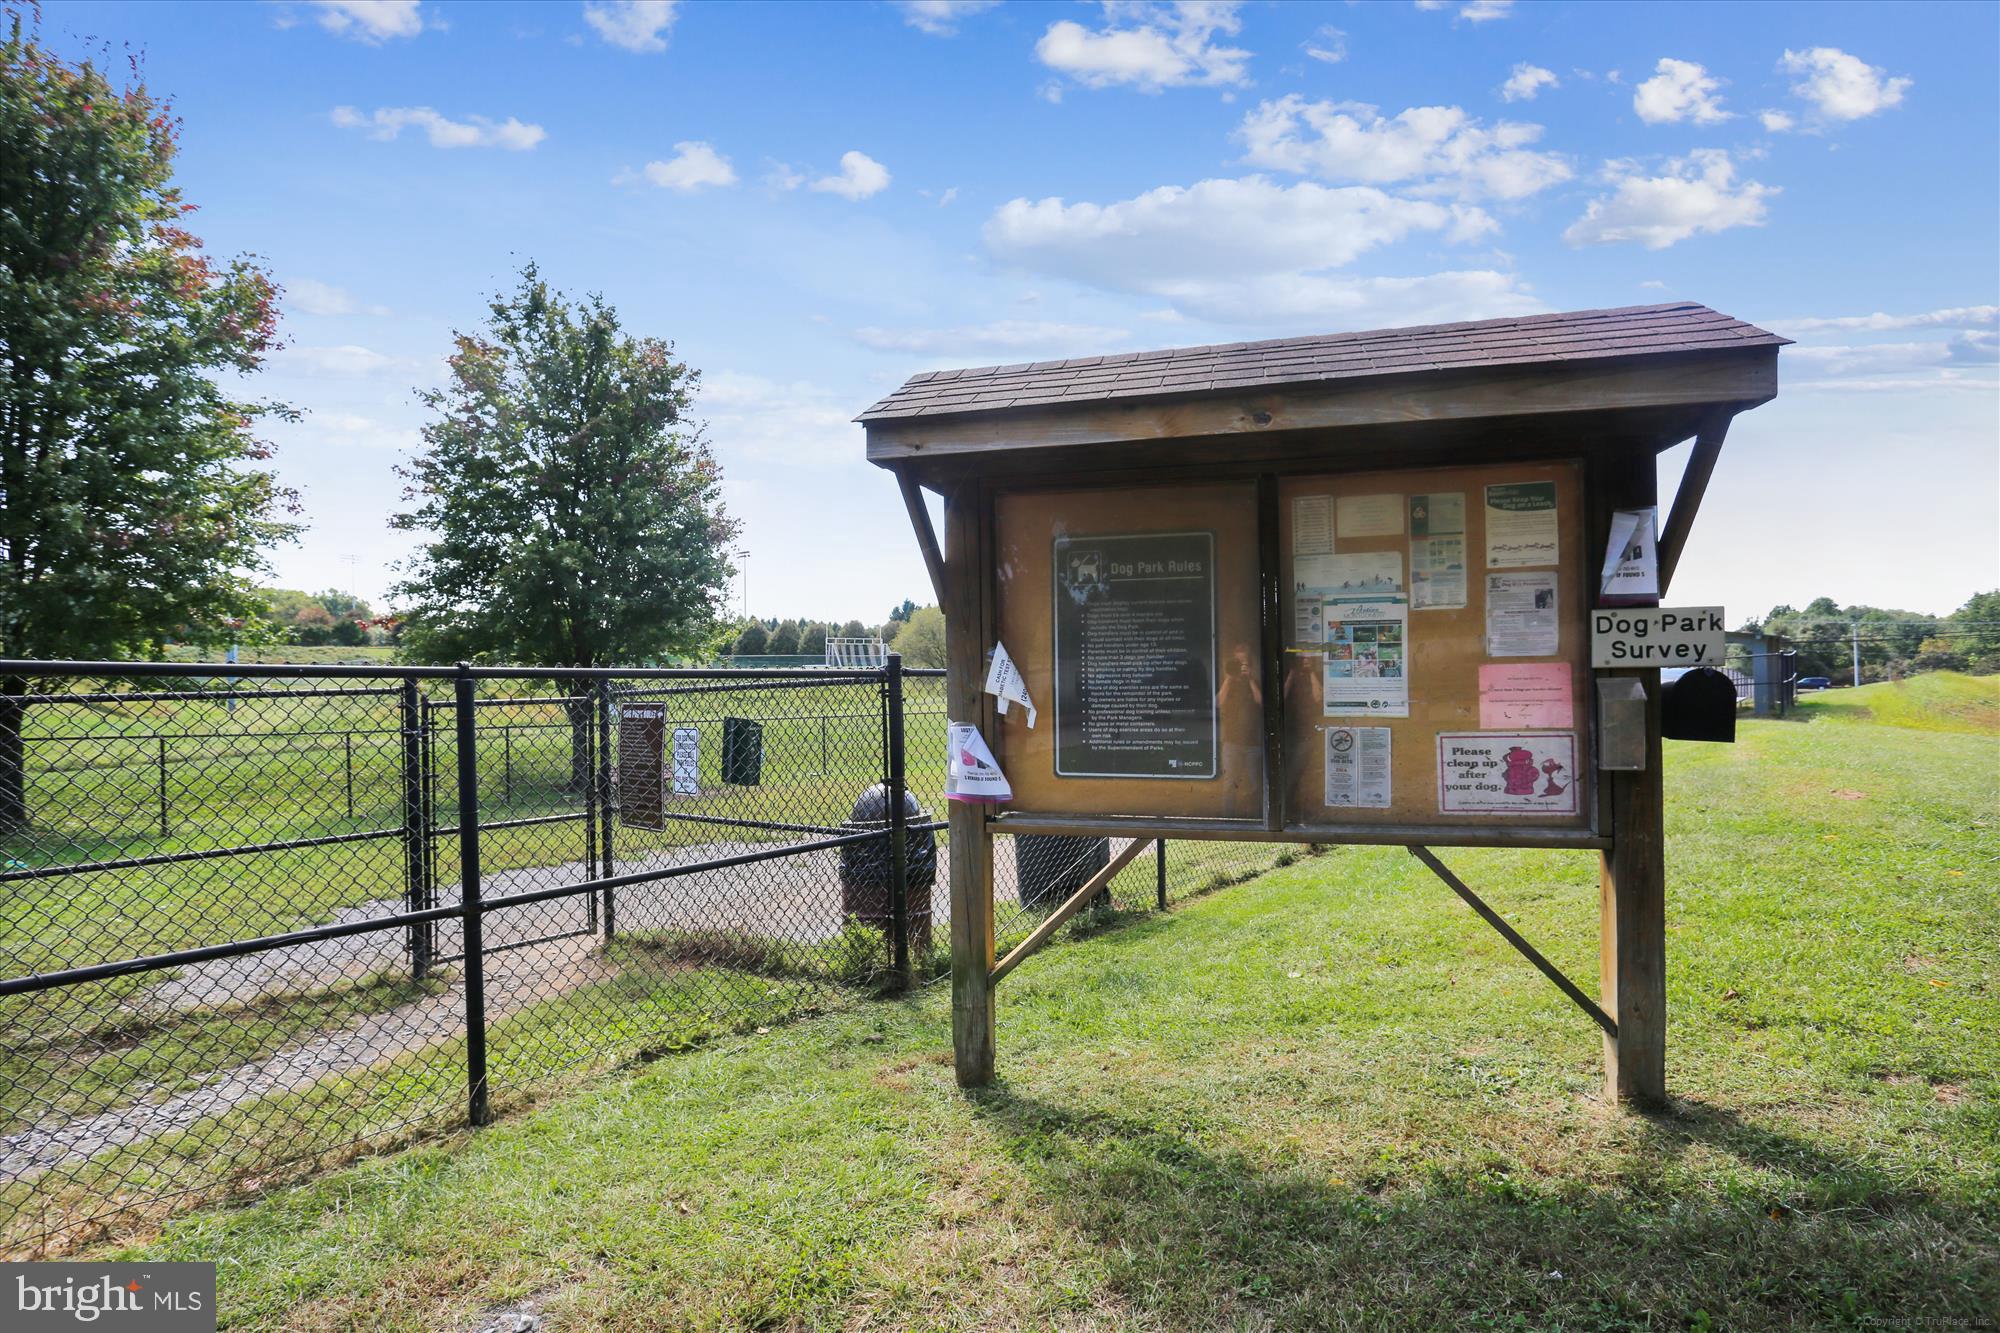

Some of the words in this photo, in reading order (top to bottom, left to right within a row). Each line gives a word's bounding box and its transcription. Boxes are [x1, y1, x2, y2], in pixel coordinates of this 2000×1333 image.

[1111, 562, 1133, 576] Dog
[1138, 561, 1164, 573] Park
[1168, 560, 1202, 572] Rules
[1596, 616, 1648, 638] Dog
[1662, 614, 1723, 632] Park
[1612, 641, 1706, 662] Survey
[1452, 747, 1492, 756] Please
[1447, 759, 1478, 768] clean
[1482, 760, 1498, 770] up
[1458, 770, 1487, 779] after
[1475, 782, 1502, 792] dog.
